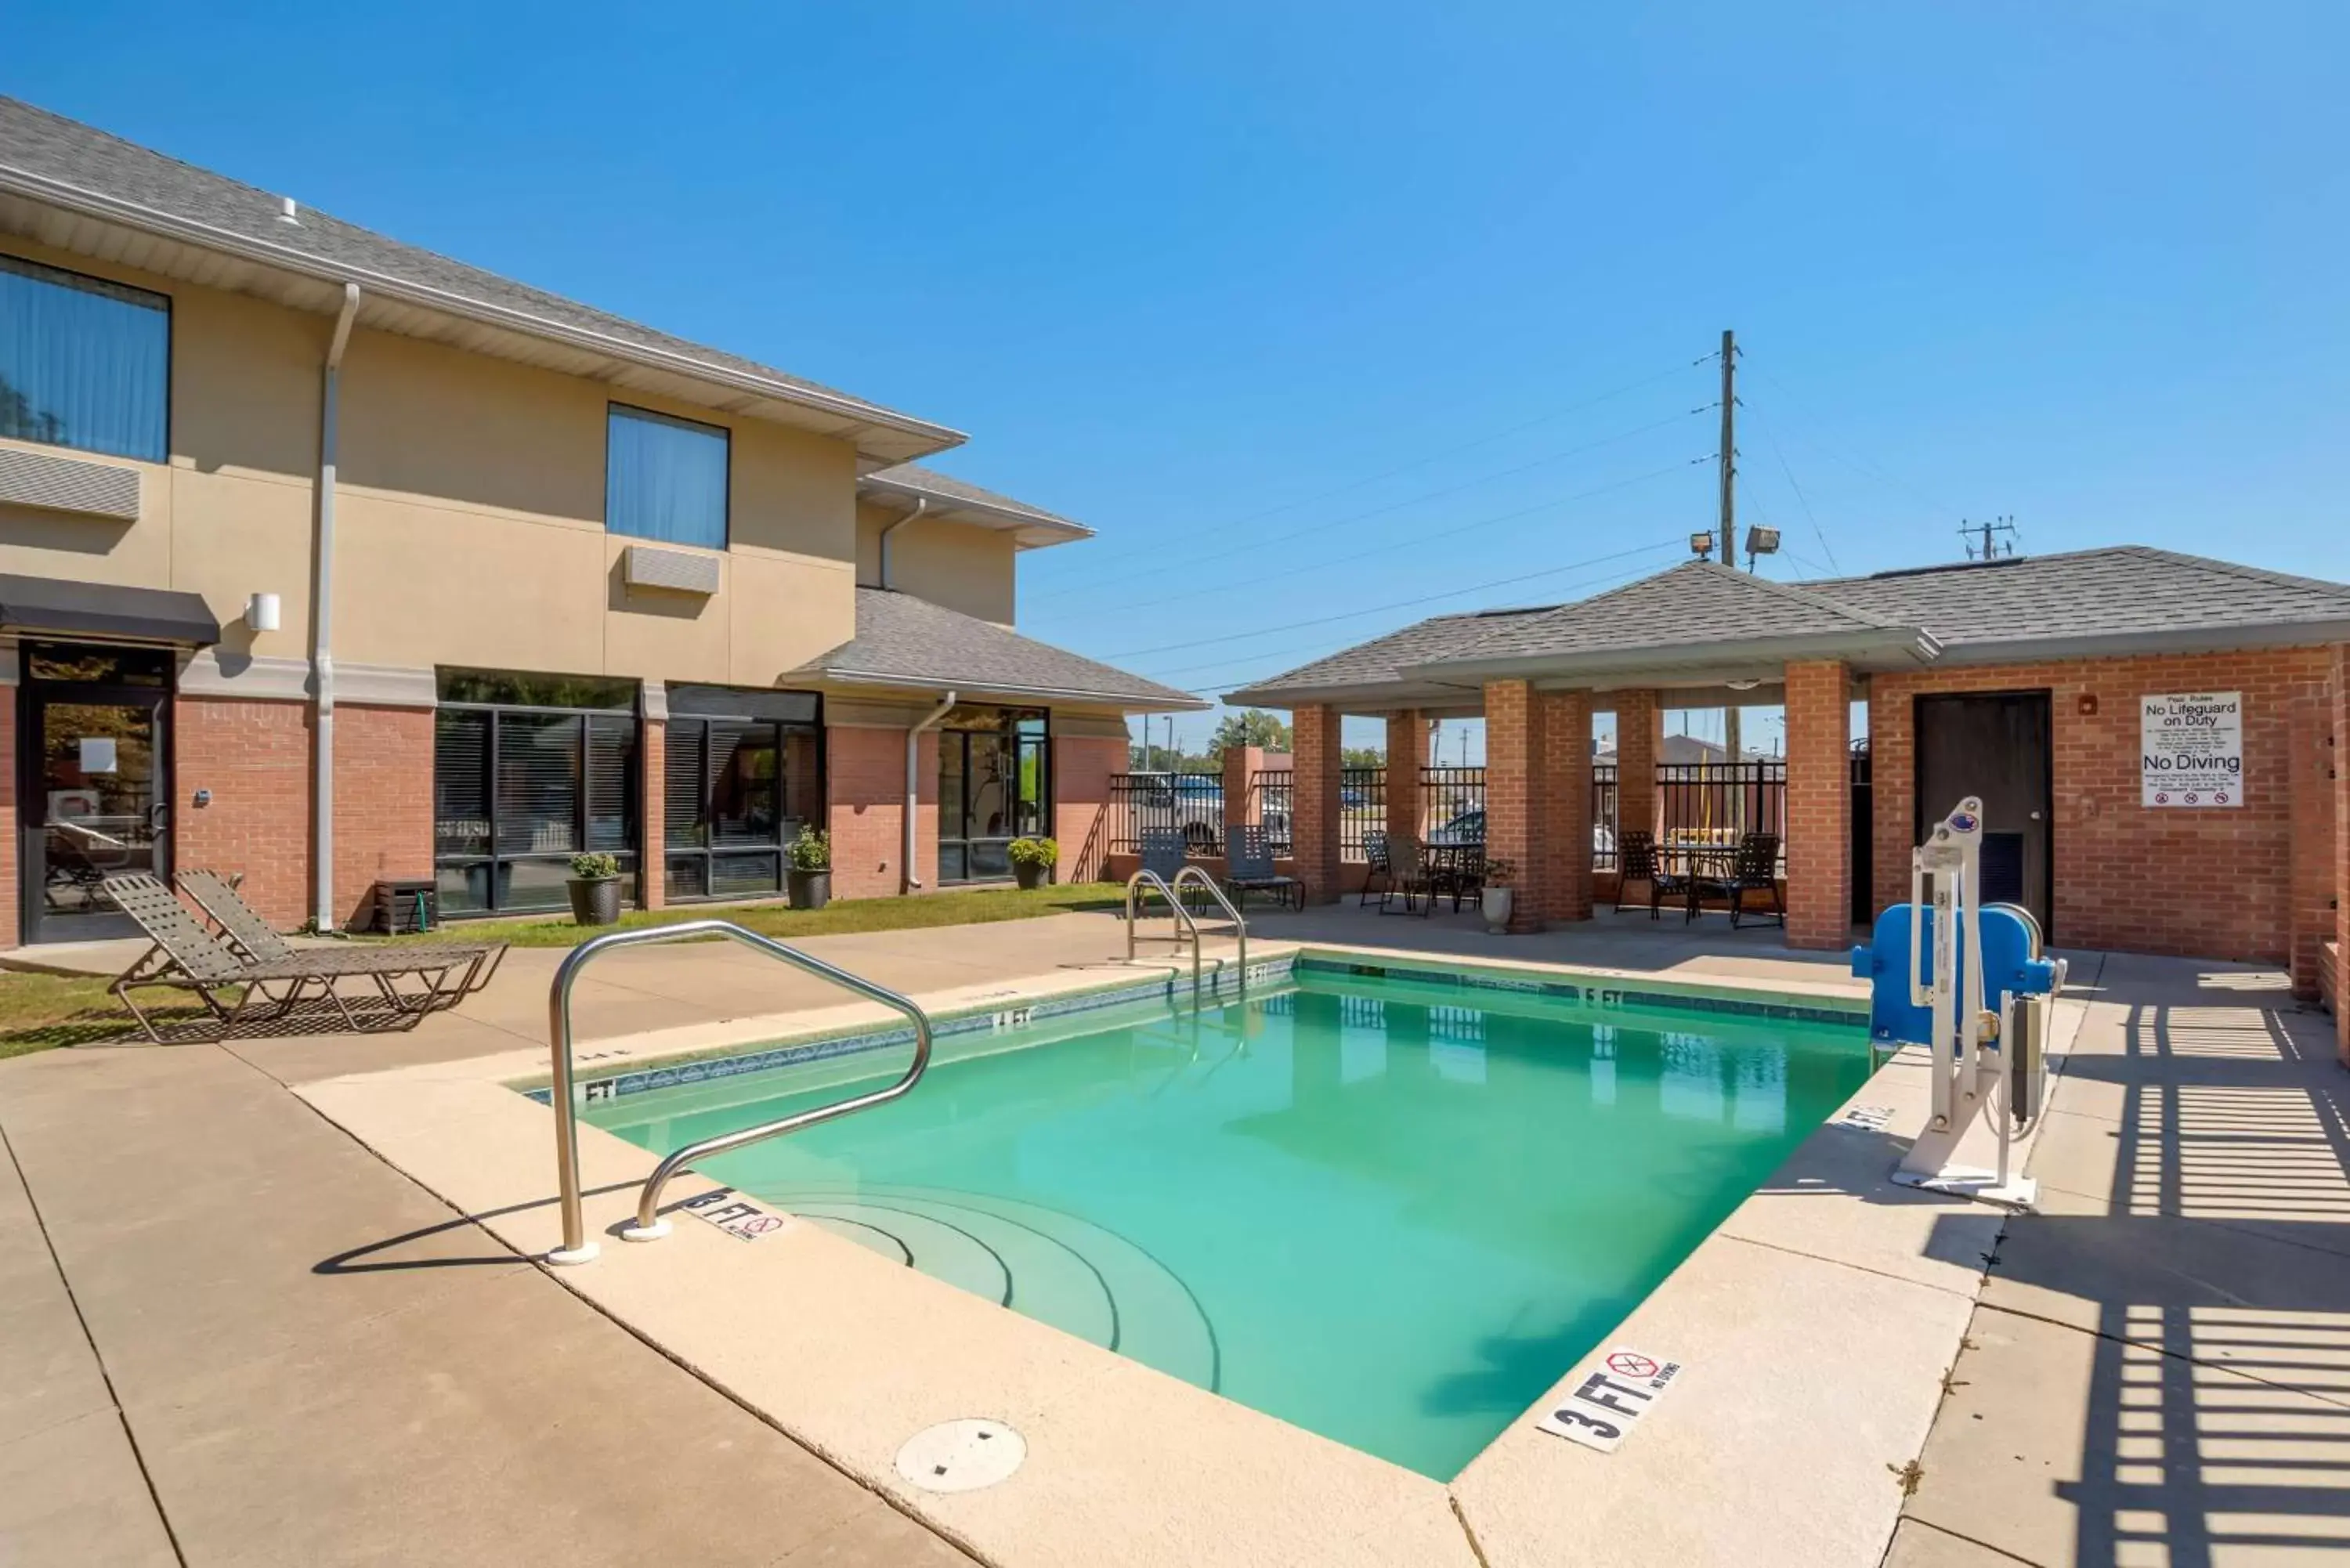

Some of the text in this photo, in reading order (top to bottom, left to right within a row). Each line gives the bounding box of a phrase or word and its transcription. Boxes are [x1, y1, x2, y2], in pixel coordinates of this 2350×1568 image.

[2146, 702, 2236, 716] No Lifeguard
[2164, 715, 2217, 727] on Duty
[2144, 753, 2240, 773] No Diving
[1602, 989, 1621, 1003] FT
[1013, 1008, 1029, 1024] FT
[585, 1078, 613, 1102] FT
[702, 1202, 763, 1223] FT
[1553, 1372, 1654, 1439] 3 FT
